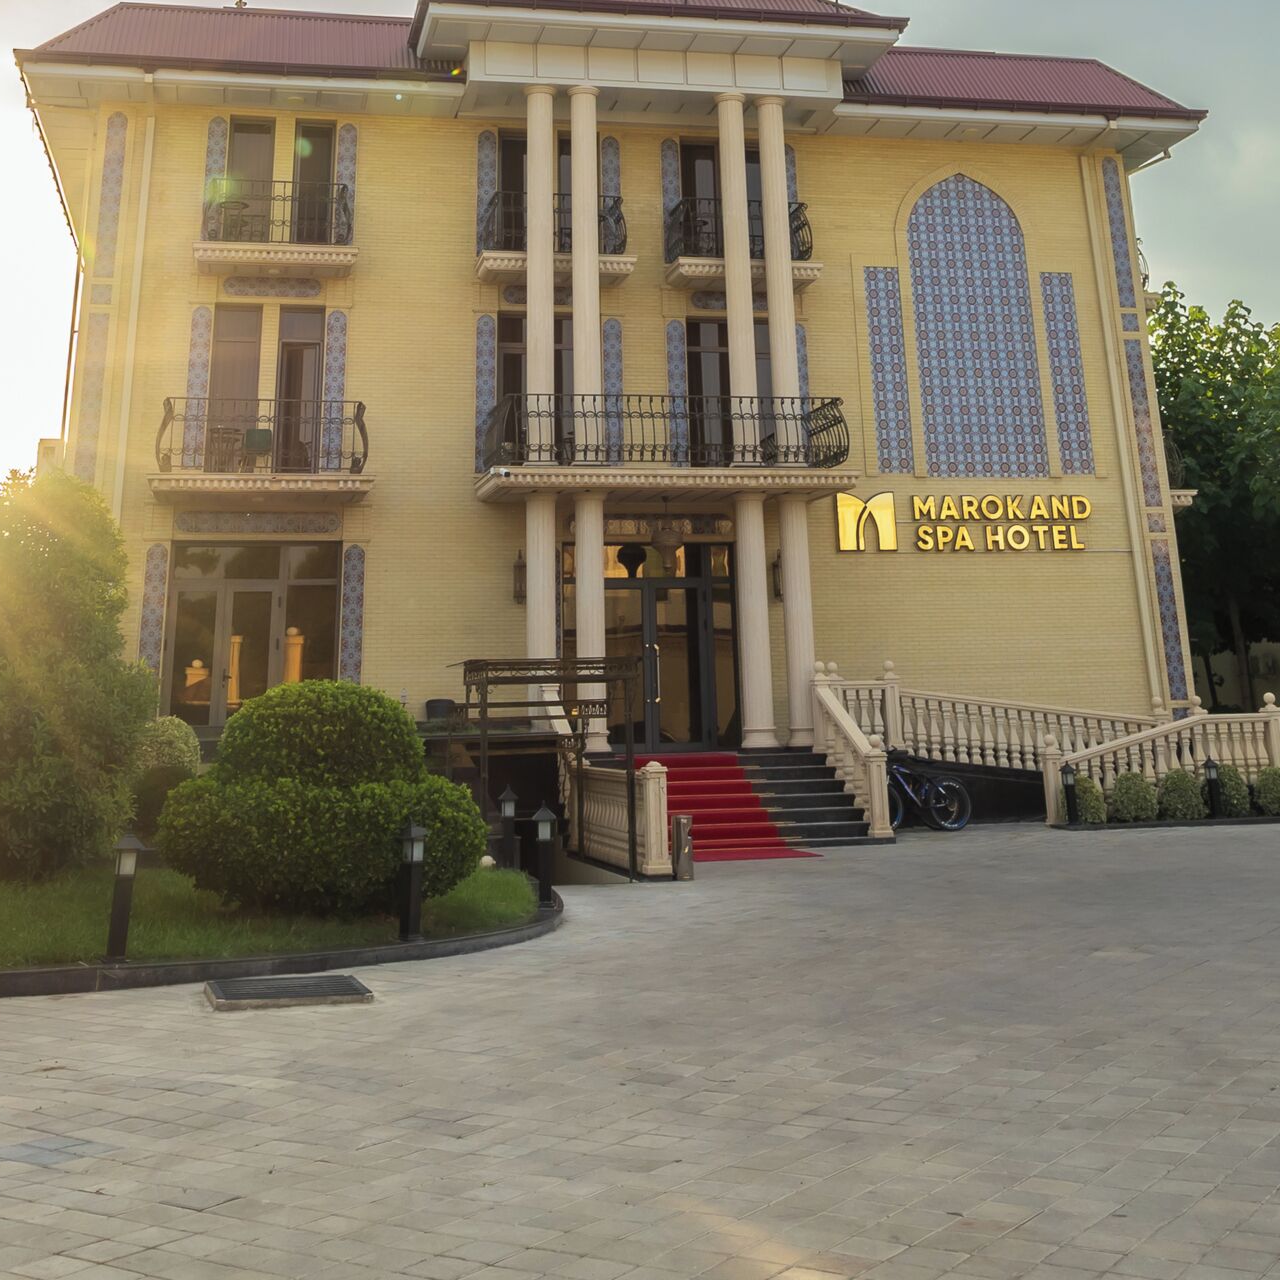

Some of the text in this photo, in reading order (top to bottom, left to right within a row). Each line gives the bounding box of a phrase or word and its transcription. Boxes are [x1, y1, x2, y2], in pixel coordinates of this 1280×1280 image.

[912, 494, 1093, 520] MAROKAND
[916, 524, 1086, 551] SPA HOTEL
